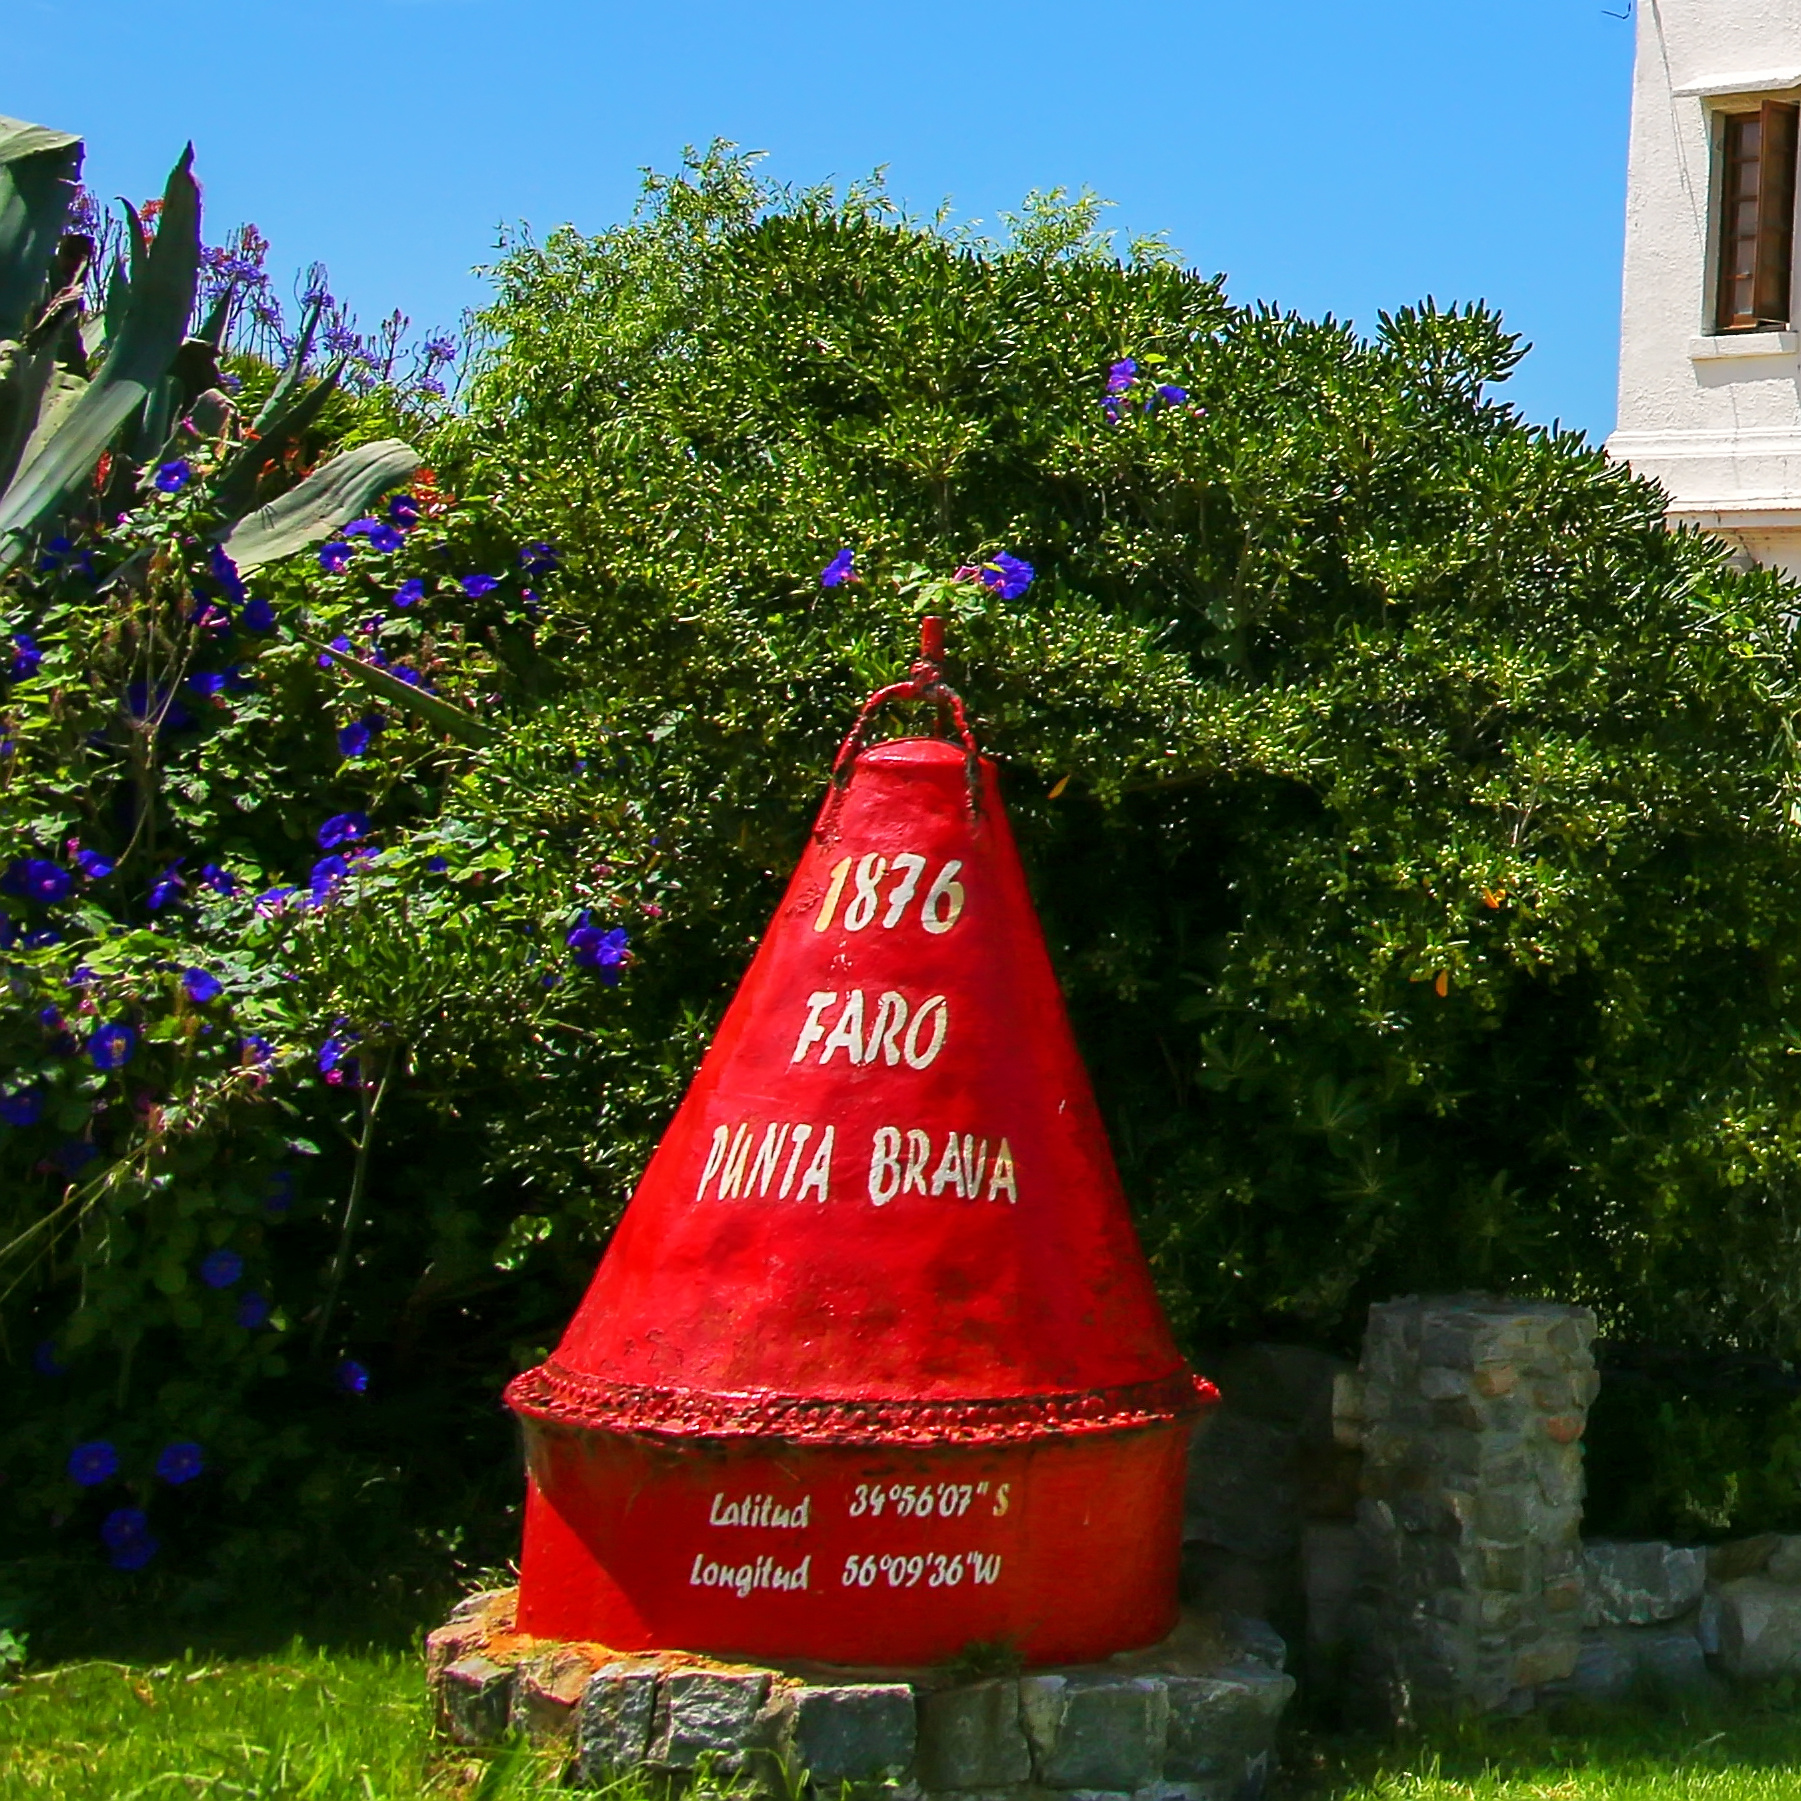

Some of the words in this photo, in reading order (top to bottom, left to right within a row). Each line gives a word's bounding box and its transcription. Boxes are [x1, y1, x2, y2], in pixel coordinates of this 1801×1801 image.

[814, 853, 964, 934] 1876
[790, 989, 947, 1070] FARO
[696, 1123, 834, 1203] PUNTA
[868, 1126, 1016, 1205] BRAVA
[709, 1493, 810, 1528] Latitud
[690, 1554, 811, 1598] Longitud
